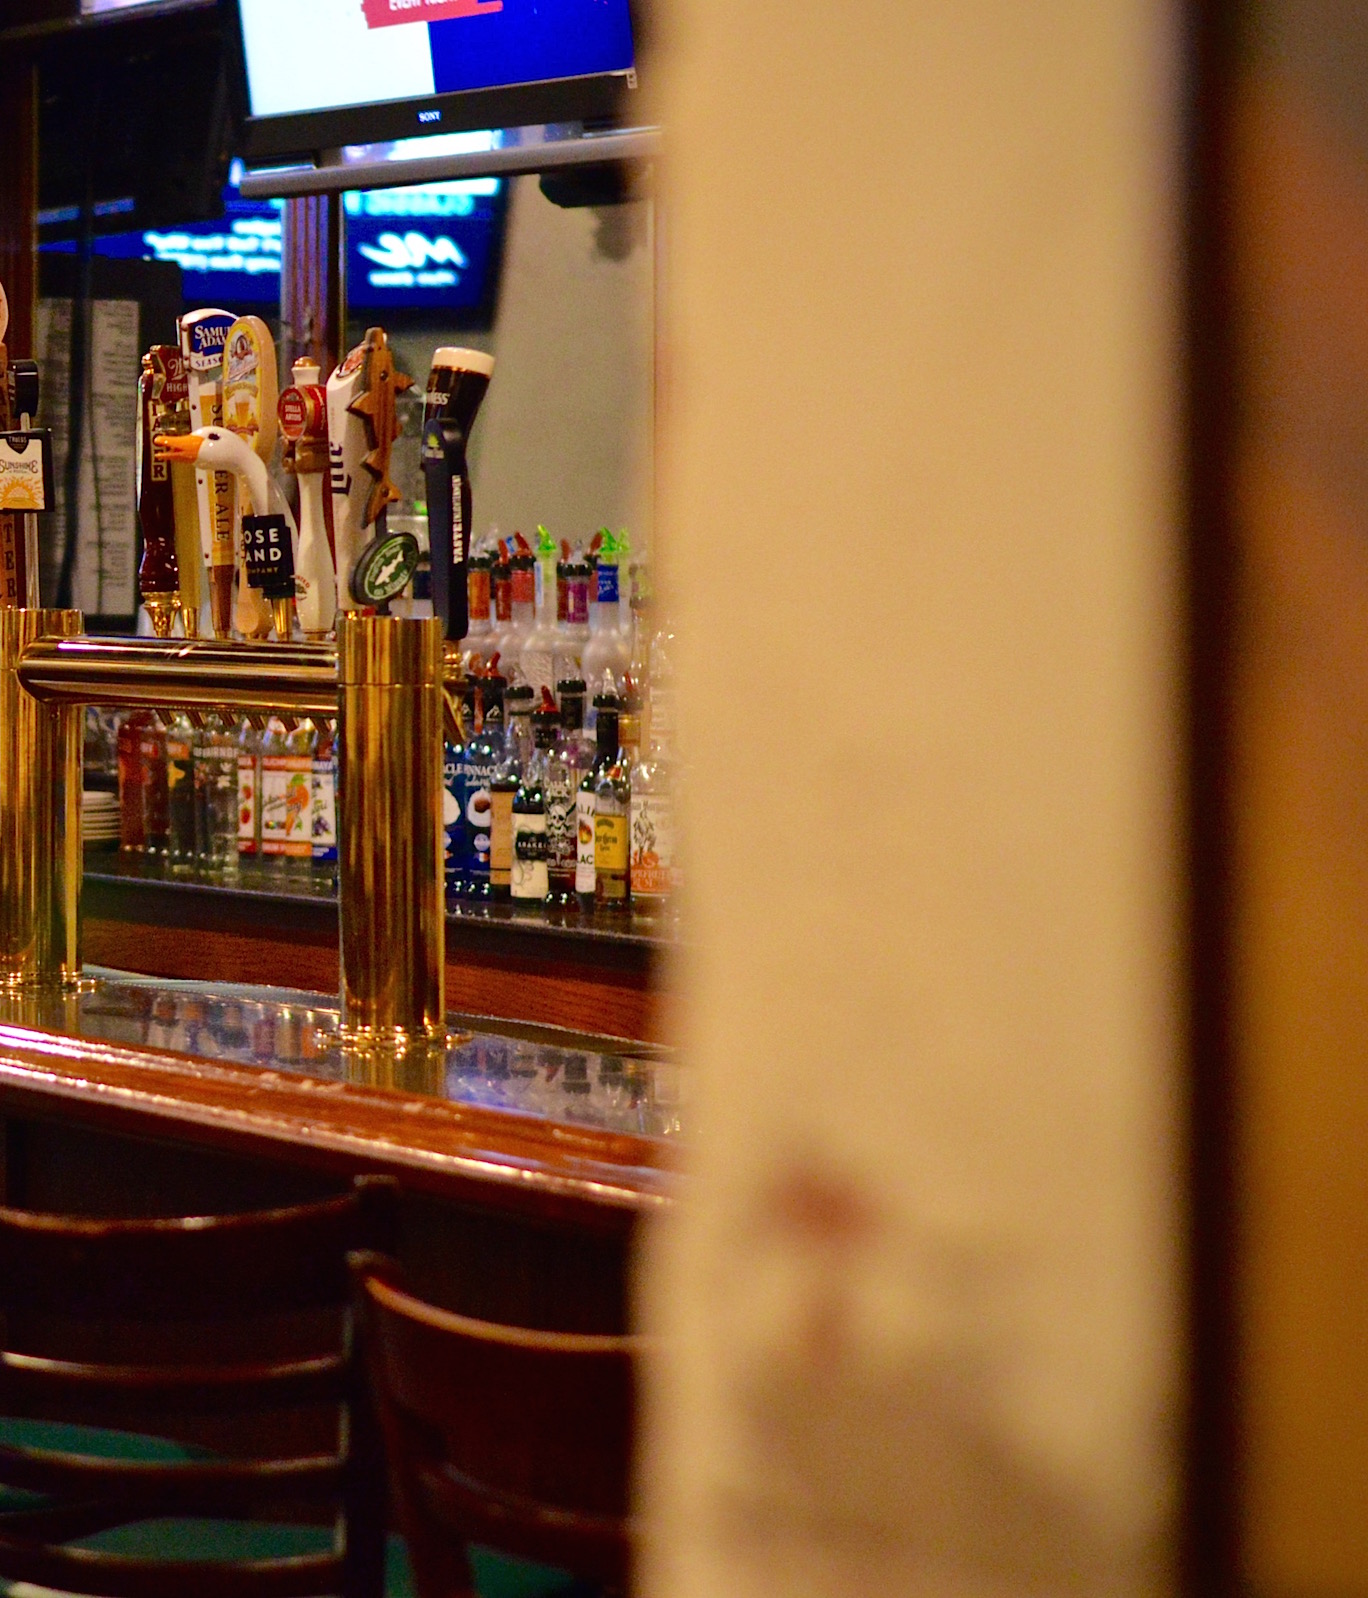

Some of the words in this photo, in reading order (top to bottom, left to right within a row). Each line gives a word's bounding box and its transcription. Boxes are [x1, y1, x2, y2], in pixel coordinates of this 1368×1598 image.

[418, 111, 440, 122] SONY
[195, 325, 231, 339] SAMU
[199, 336, 225, 350] ADA
[211, 404, 228, 494] SUER
[215, 503, 229, 541] ALE
[244, 528, 280, 544] OSE
[245, 548, 282, 562] AND
[464, 763, 496, 776] PINNAC
